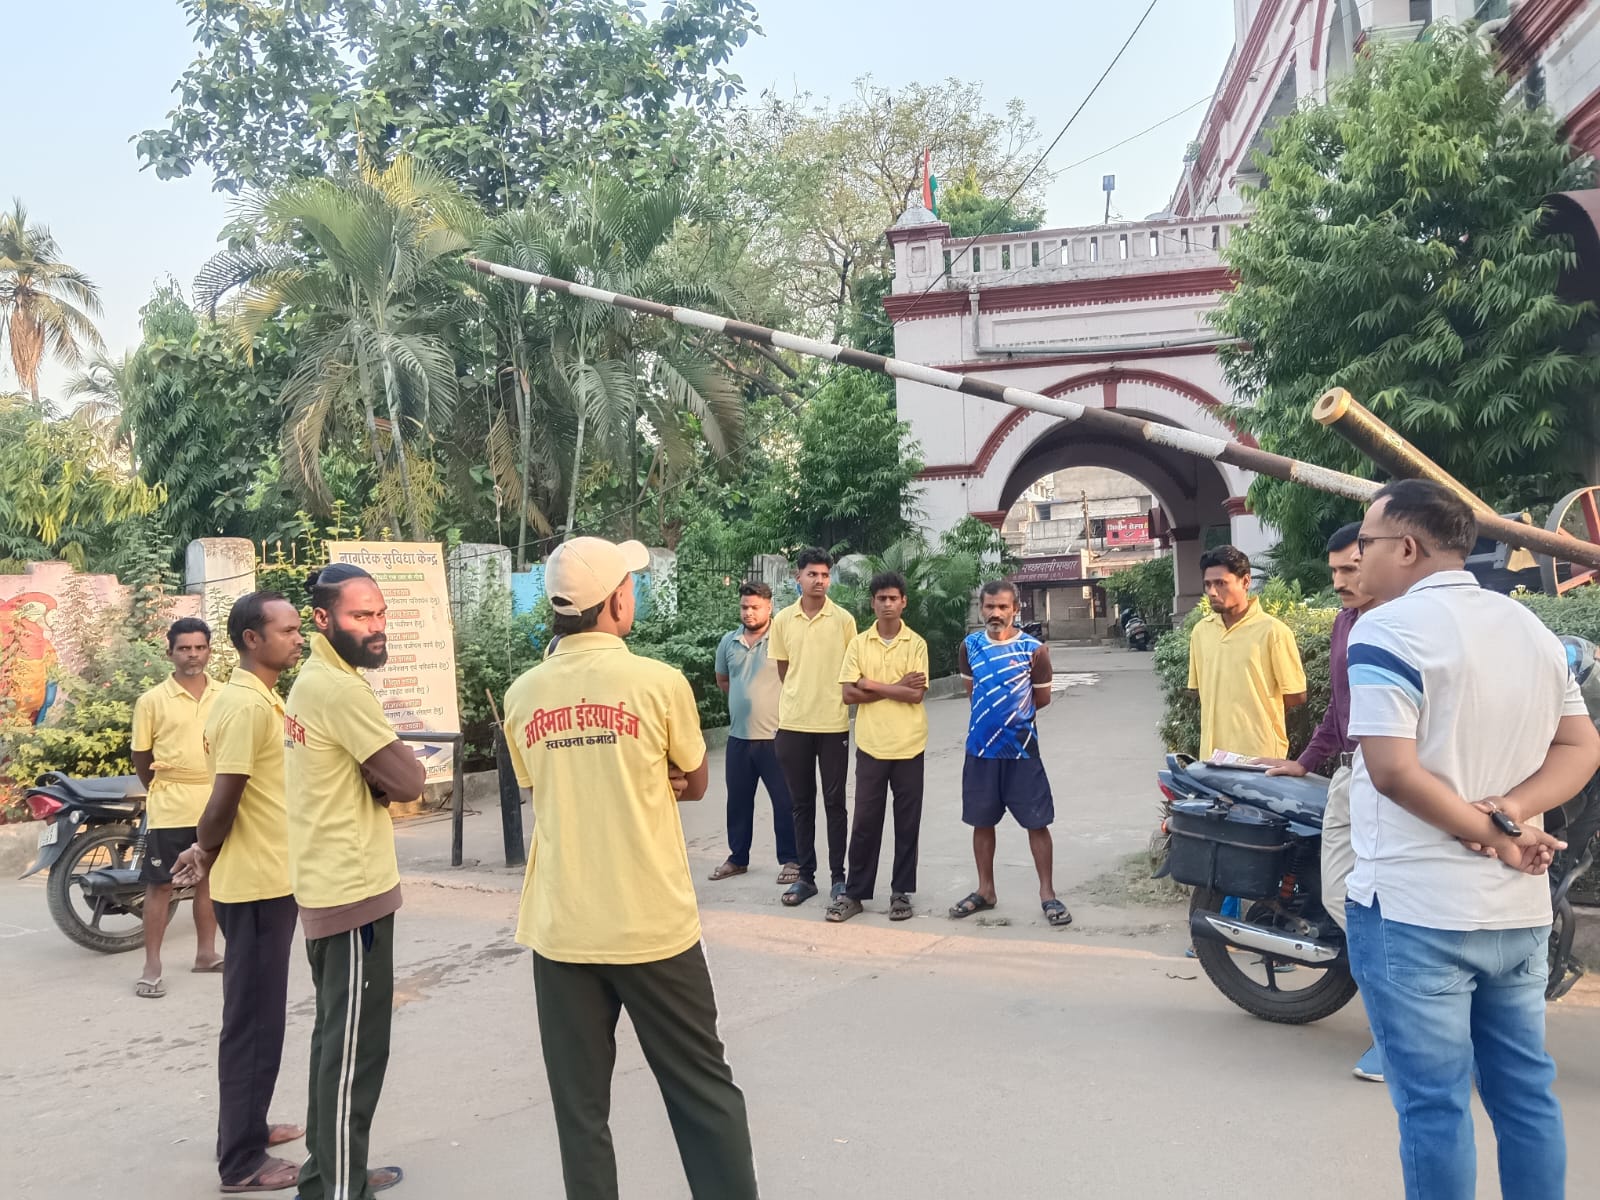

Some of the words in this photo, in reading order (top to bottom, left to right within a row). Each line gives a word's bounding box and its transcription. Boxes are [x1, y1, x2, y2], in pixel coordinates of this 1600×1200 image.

[339, 548, 380, 564] नागरिक
[382, 549, 416, 569] सुविधा
[416, 549, 438, 565] केन्द्र
[525, 707, 572, 749] अस्मिता
[575, 697, 640, 739] इंटरप्राईज
[545, 736, 584, 750] स्वच्छता
[585, 731, 617, 746] कमांडो
